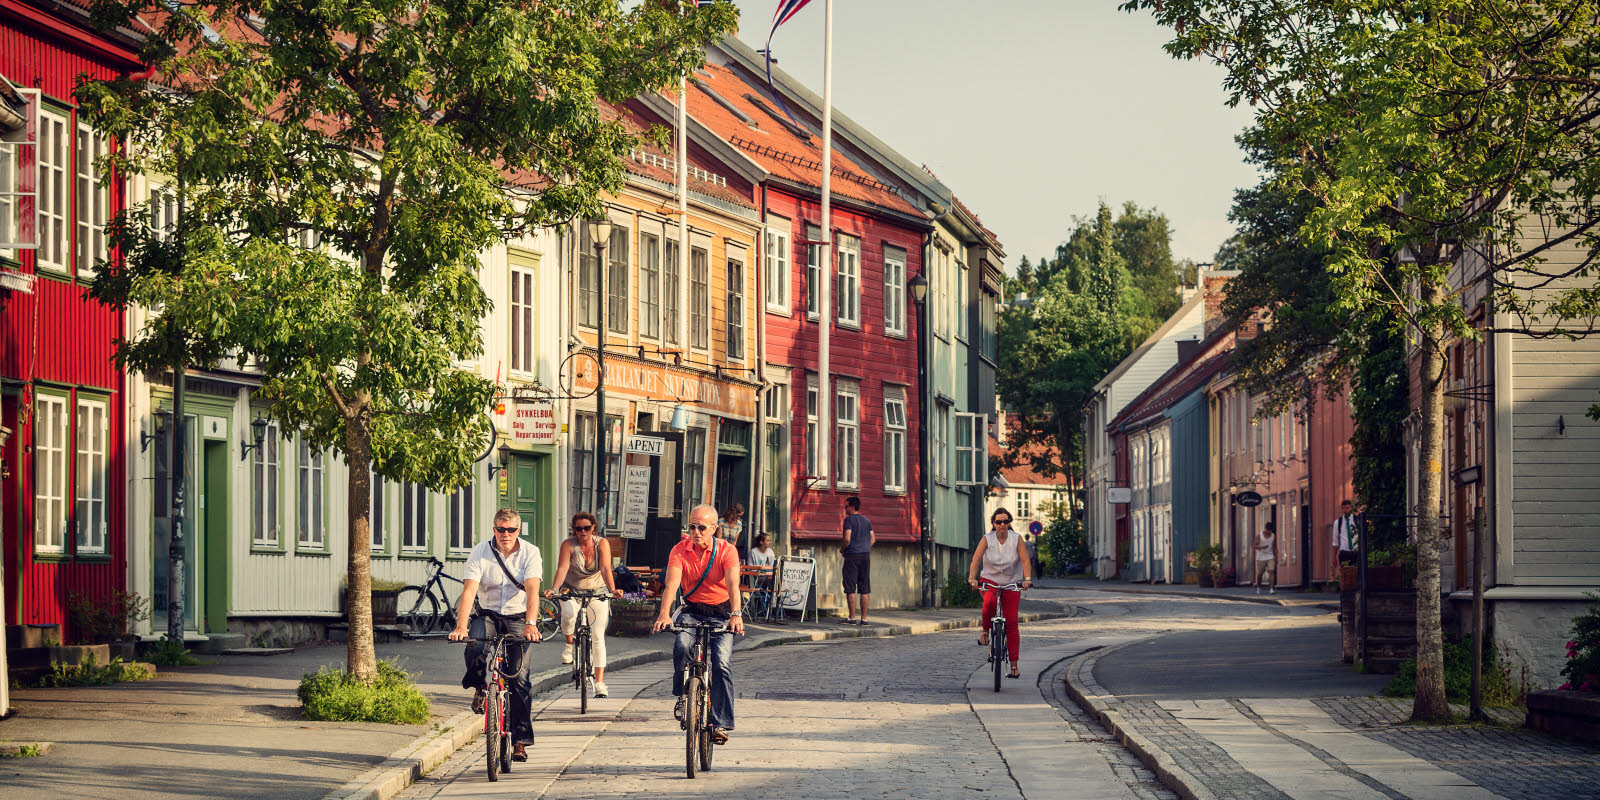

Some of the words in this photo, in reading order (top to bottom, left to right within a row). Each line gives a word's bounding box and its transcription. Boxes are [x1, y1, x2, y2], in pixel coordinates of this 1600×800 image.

[603, 362, 658, 393] BAKLANDET
[664, 374, 720, 406] SKYDSSTATION
[516, 409, 552, 418] SYKKELBUA
[512, 421, 525, 430] Salg
[535, 421, 557, 429] Service
[515, 431, 553, 440] Reparasjoner
[629, 470, 648, 478] KAFÉ
